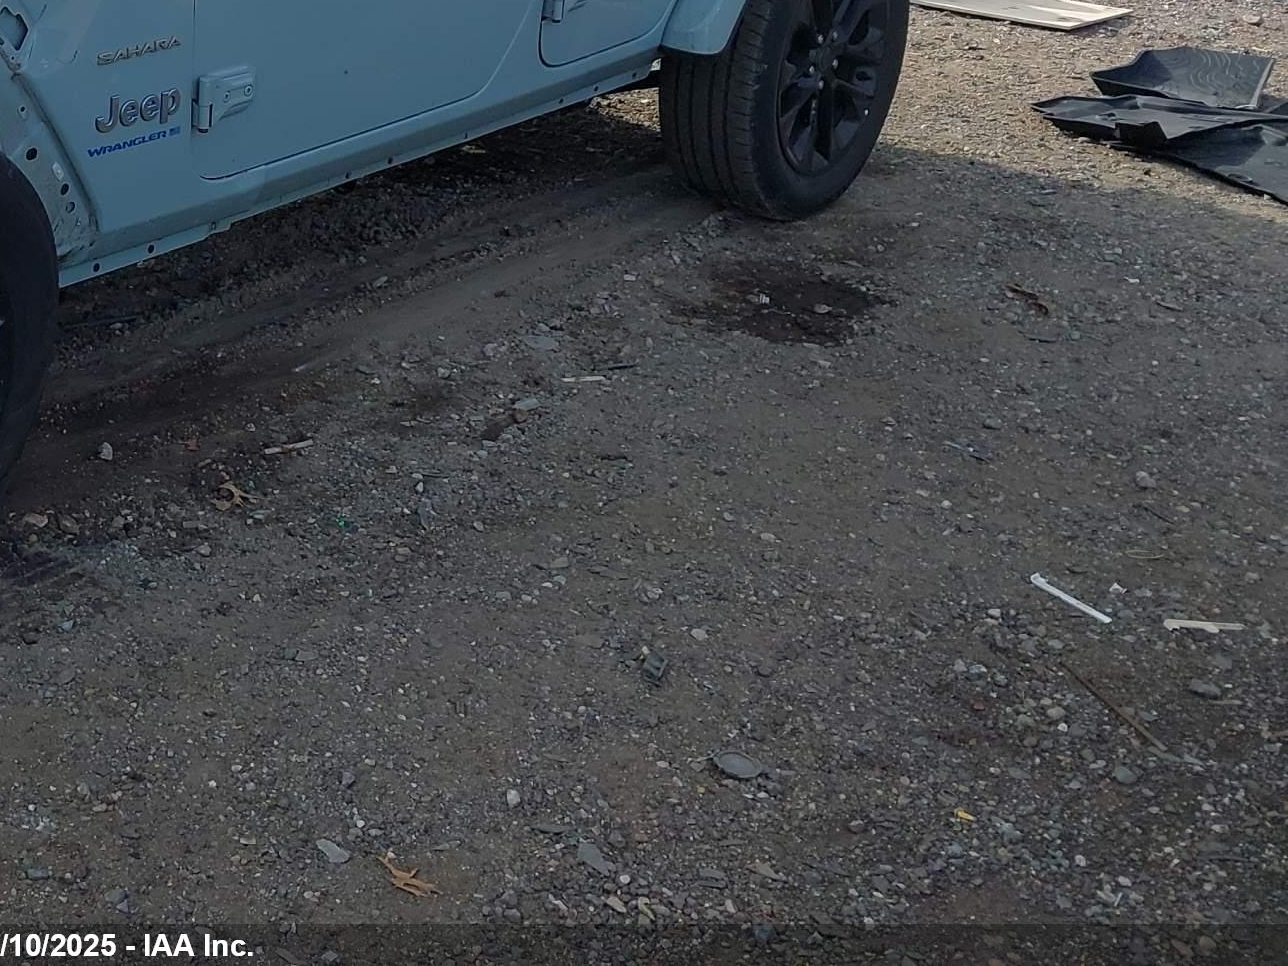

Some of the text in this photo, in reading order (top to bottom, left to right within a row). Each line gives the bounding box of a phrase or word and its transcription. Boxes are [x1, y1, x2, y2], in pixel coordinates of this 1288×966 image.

[96, 36, 183, 66] SAHARA
[95, 87, 181, 134] Jeep
[87, 130, 167, 158] WRANGLER
